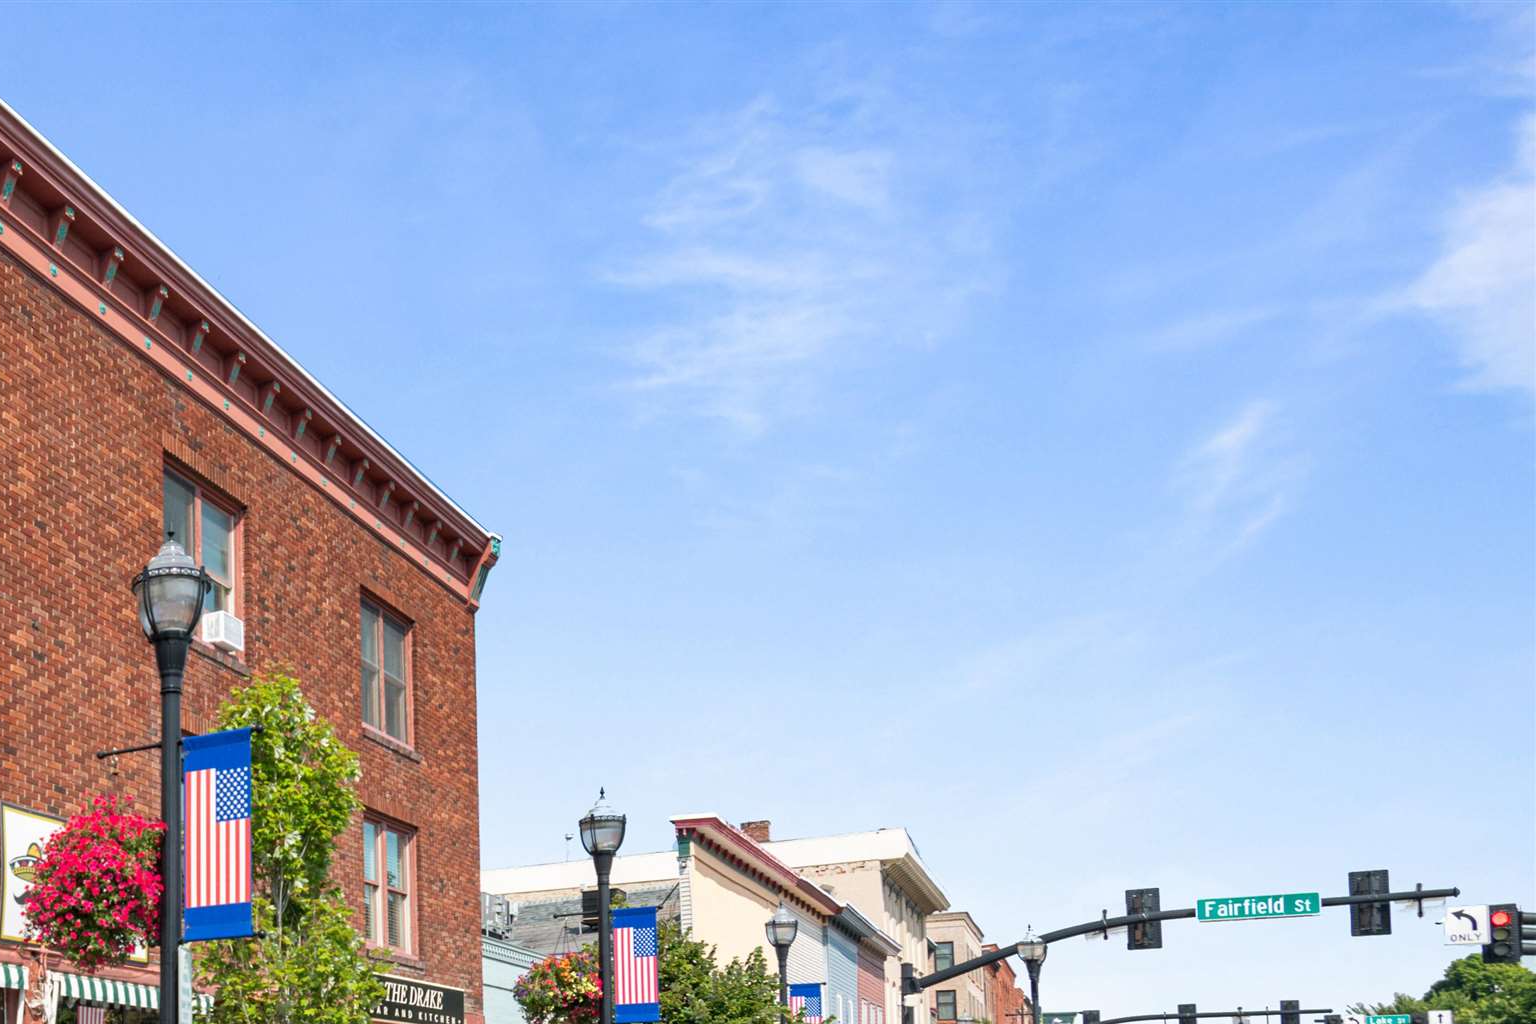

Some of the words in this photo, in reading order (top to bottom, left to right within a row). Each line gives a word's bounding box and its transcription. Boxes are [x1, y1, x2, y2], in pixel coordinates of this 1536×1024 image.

[1204, 896, 1285, 918] Fairfield
[1294, 899, 1312, 912] St
[1450, 932, 1481, 942] ONLY
[384, 981, 408, 1004] THE
[409, 986, 443, 1010] DRAKE
[394, 1008, 413, 1019] AND
[418, 1012, 456, 1024] KITCHEN
[1369, 1016, 1393, 1024] Lake
